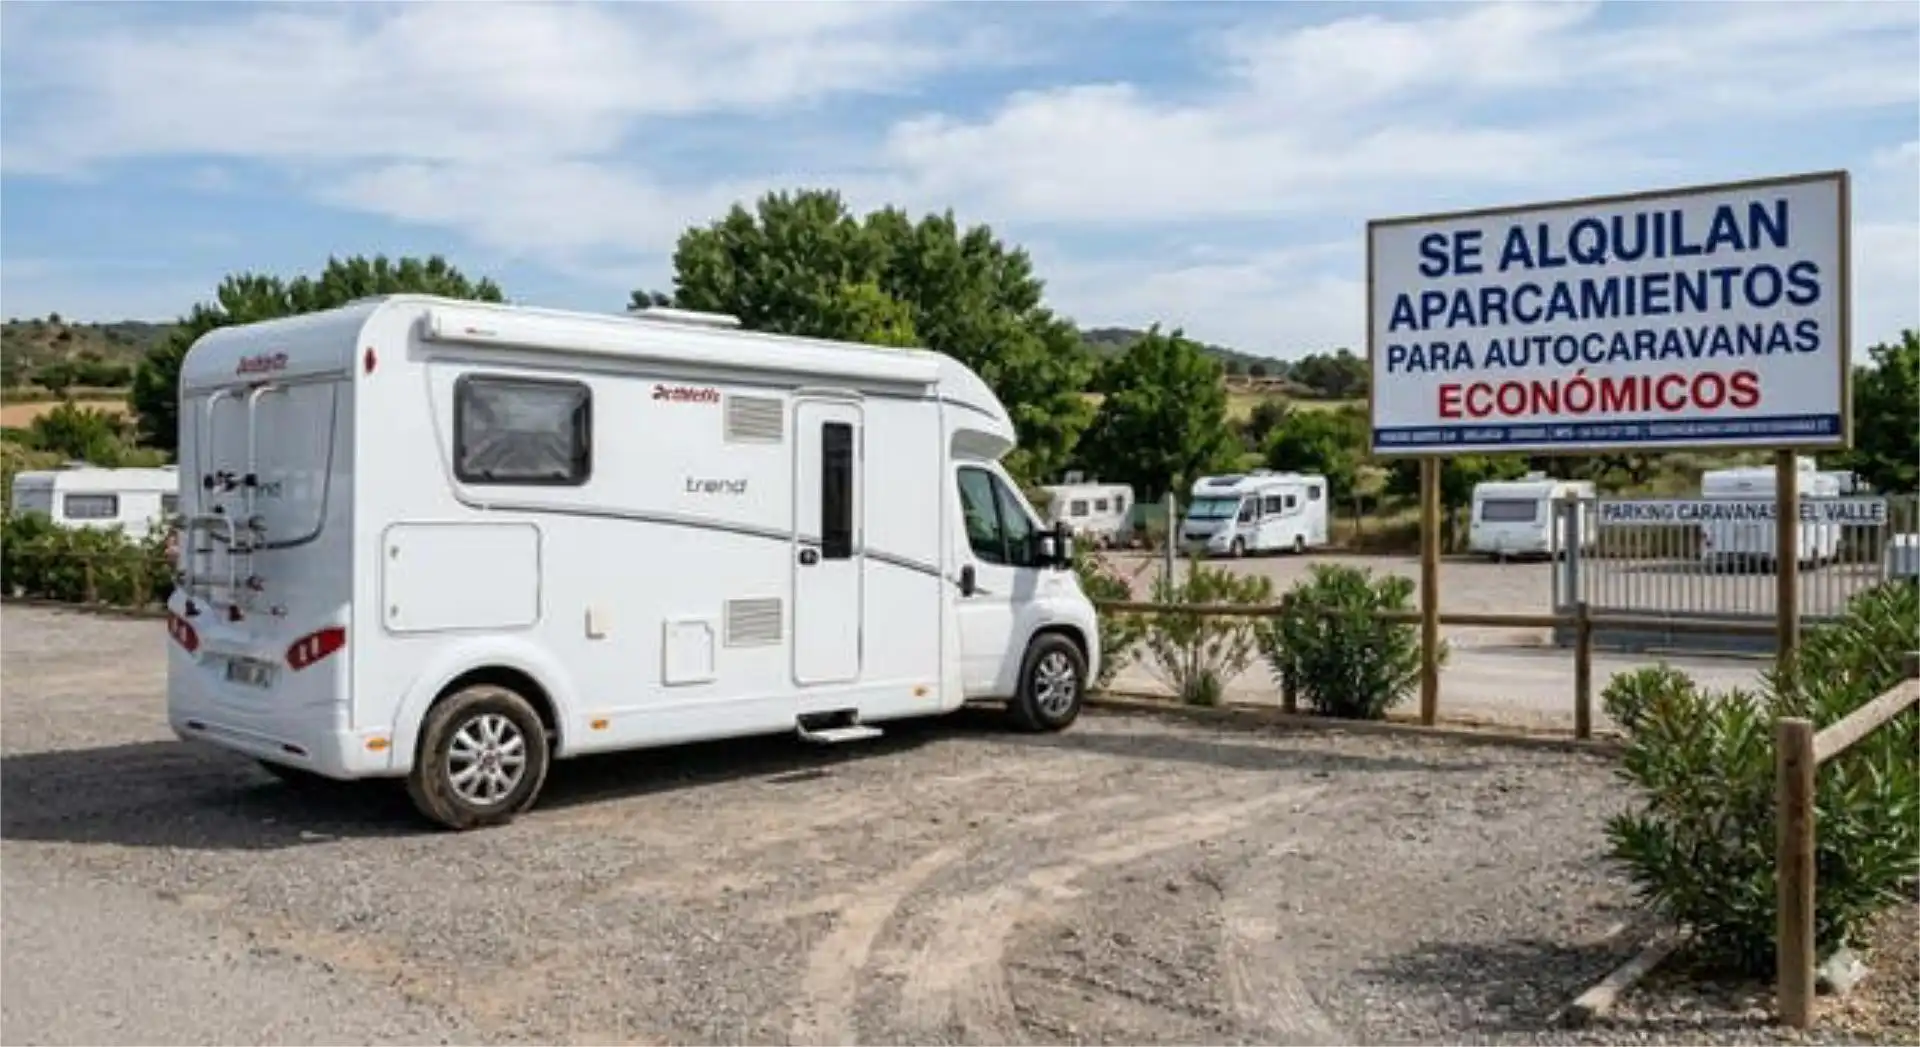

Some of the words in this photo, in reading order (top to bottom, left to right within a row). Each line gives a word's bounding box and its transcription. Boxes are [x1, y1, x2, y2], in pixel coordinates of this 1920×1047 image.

[1419, 230, 1482, 277] SE
[1499, 200, 1788, 271] ALQUILAN
[1388, 261, 1820, 332] APARCAMIENTOS
[1387, 341, 1473, 373] PARA
[1485, 321, 1820, 369] AUTOCARAVANAS
[1438, 368, 1760, 419] ECONÓMICOS
[686, 476, 747, 495] trend
[1603, 503, 1674, 520] PARKING
[1825, 502, 1883, 521] VALLE
